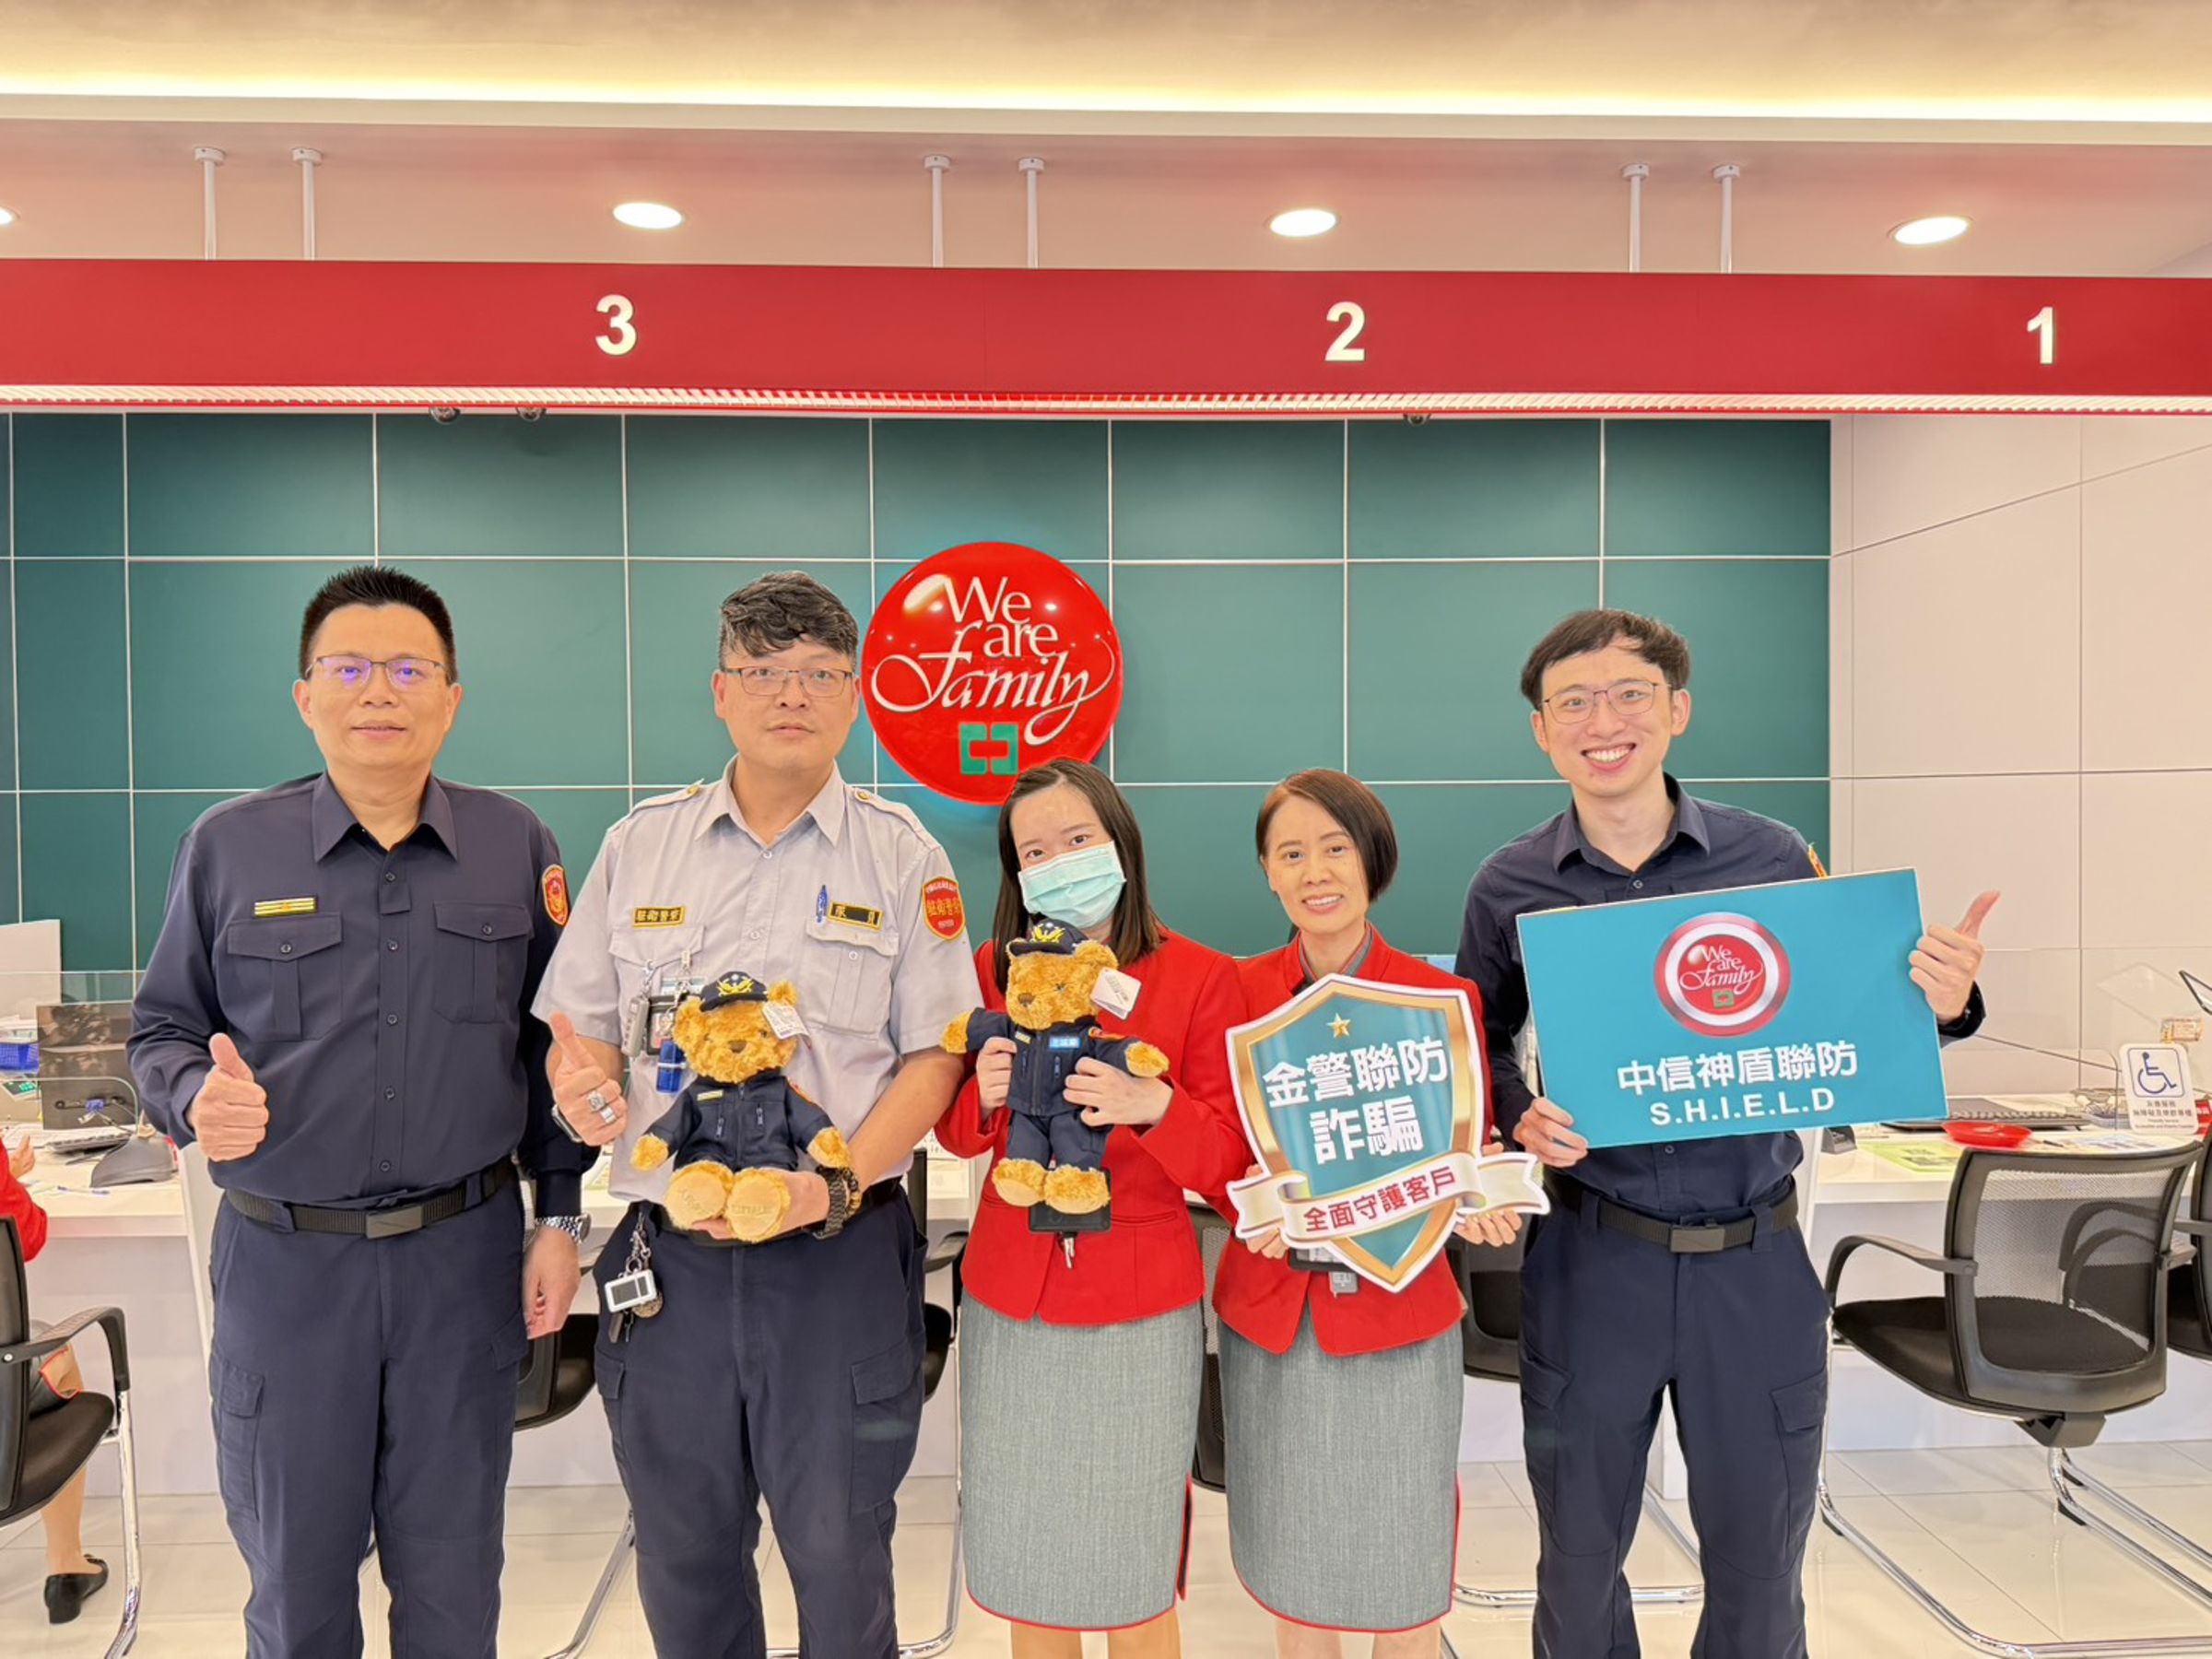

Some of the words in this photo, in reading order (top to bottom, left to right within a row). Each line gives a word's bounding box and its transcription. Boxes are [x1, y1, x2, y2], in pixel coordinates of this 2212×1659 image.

[595, 294, 638, 356] 3
[1324, 300, 1366, 362] 2
[2027, 306, 2055, 366] 1
[942, 576, 1032, 624] We
[982, 620, 1059, 658] are
[1701, 944, 1733, 962] We
[1715, 956, 1742, 971] are
[1262, 1035, 1449, 1109] 金警聯防
[1616, 1039, 1859, 1097] 中信神盾聯防
[1309, 1095, 1425, 1166] 詐騙
[1649, 1087, 1836, 1126] S.H.I.E.L.D
[1302, 1165, 1456, 1233] 全面守護客戶
